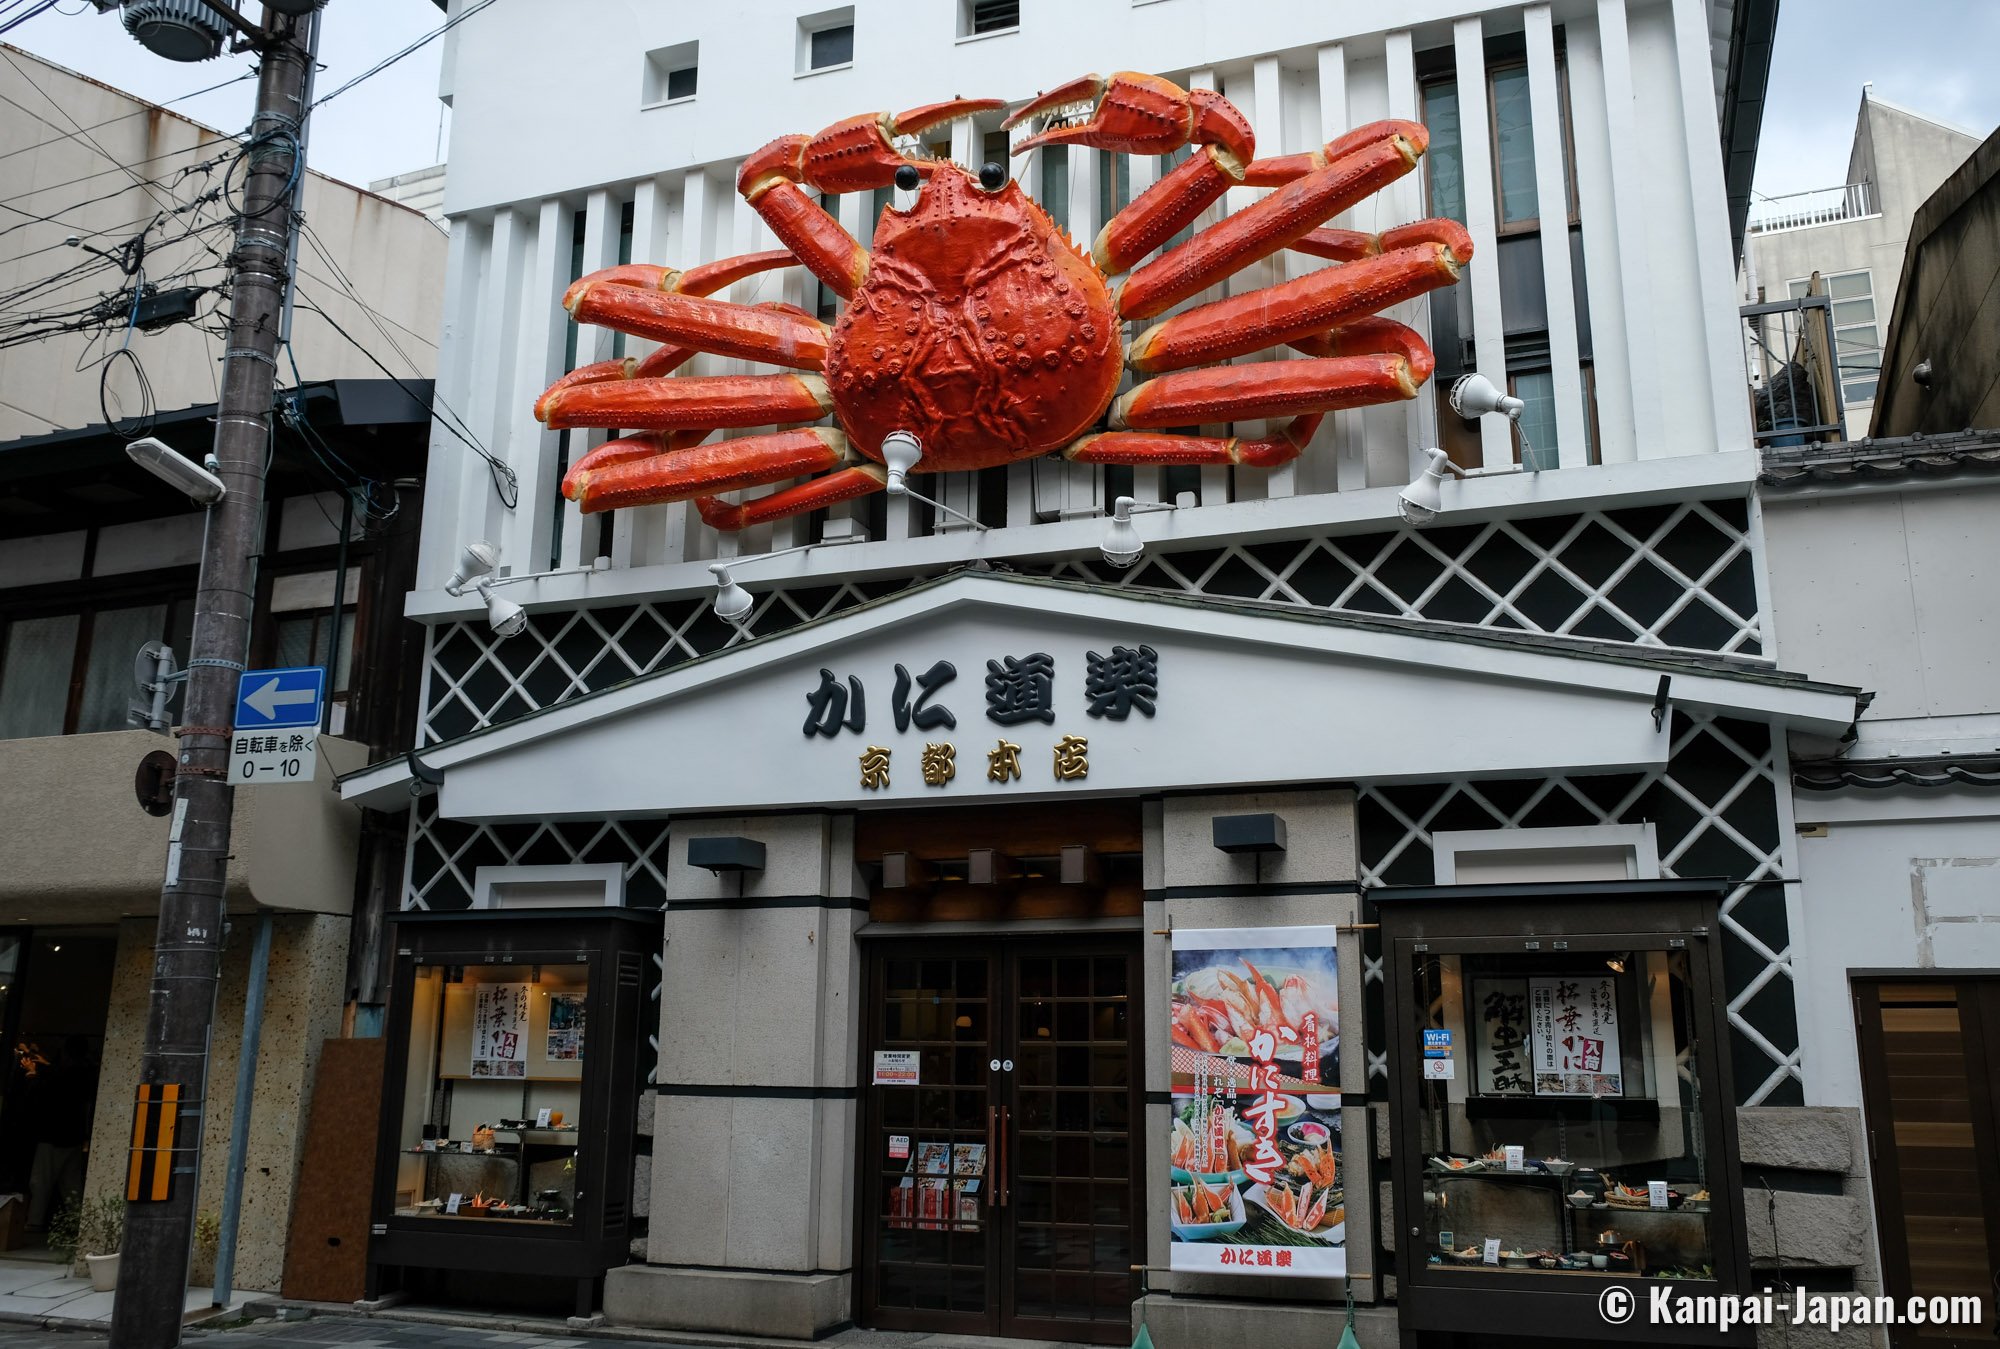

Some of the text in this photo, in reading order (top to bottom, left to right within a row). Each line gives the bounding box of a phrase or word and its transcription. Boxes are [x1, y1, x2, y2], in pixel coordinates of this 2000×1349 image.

[803, 644, 1159, 738] かに道楽
[235, 734, 314, 755] 自転車を除く
[858, 734, 1090, 790] 京都本店
[1599, 980, 1614, 1025] 冬の味覚
[1302, 1013, 1319, 1082] 看板料理
[1426, 1033, 1449, 1041] Wi-Fi
[1584, 1040, 1601, 1071] 入荷
[1245, 1026, 1298, 1183] かにすき
[1220, 1247, 1292, 1267] かに道楽
